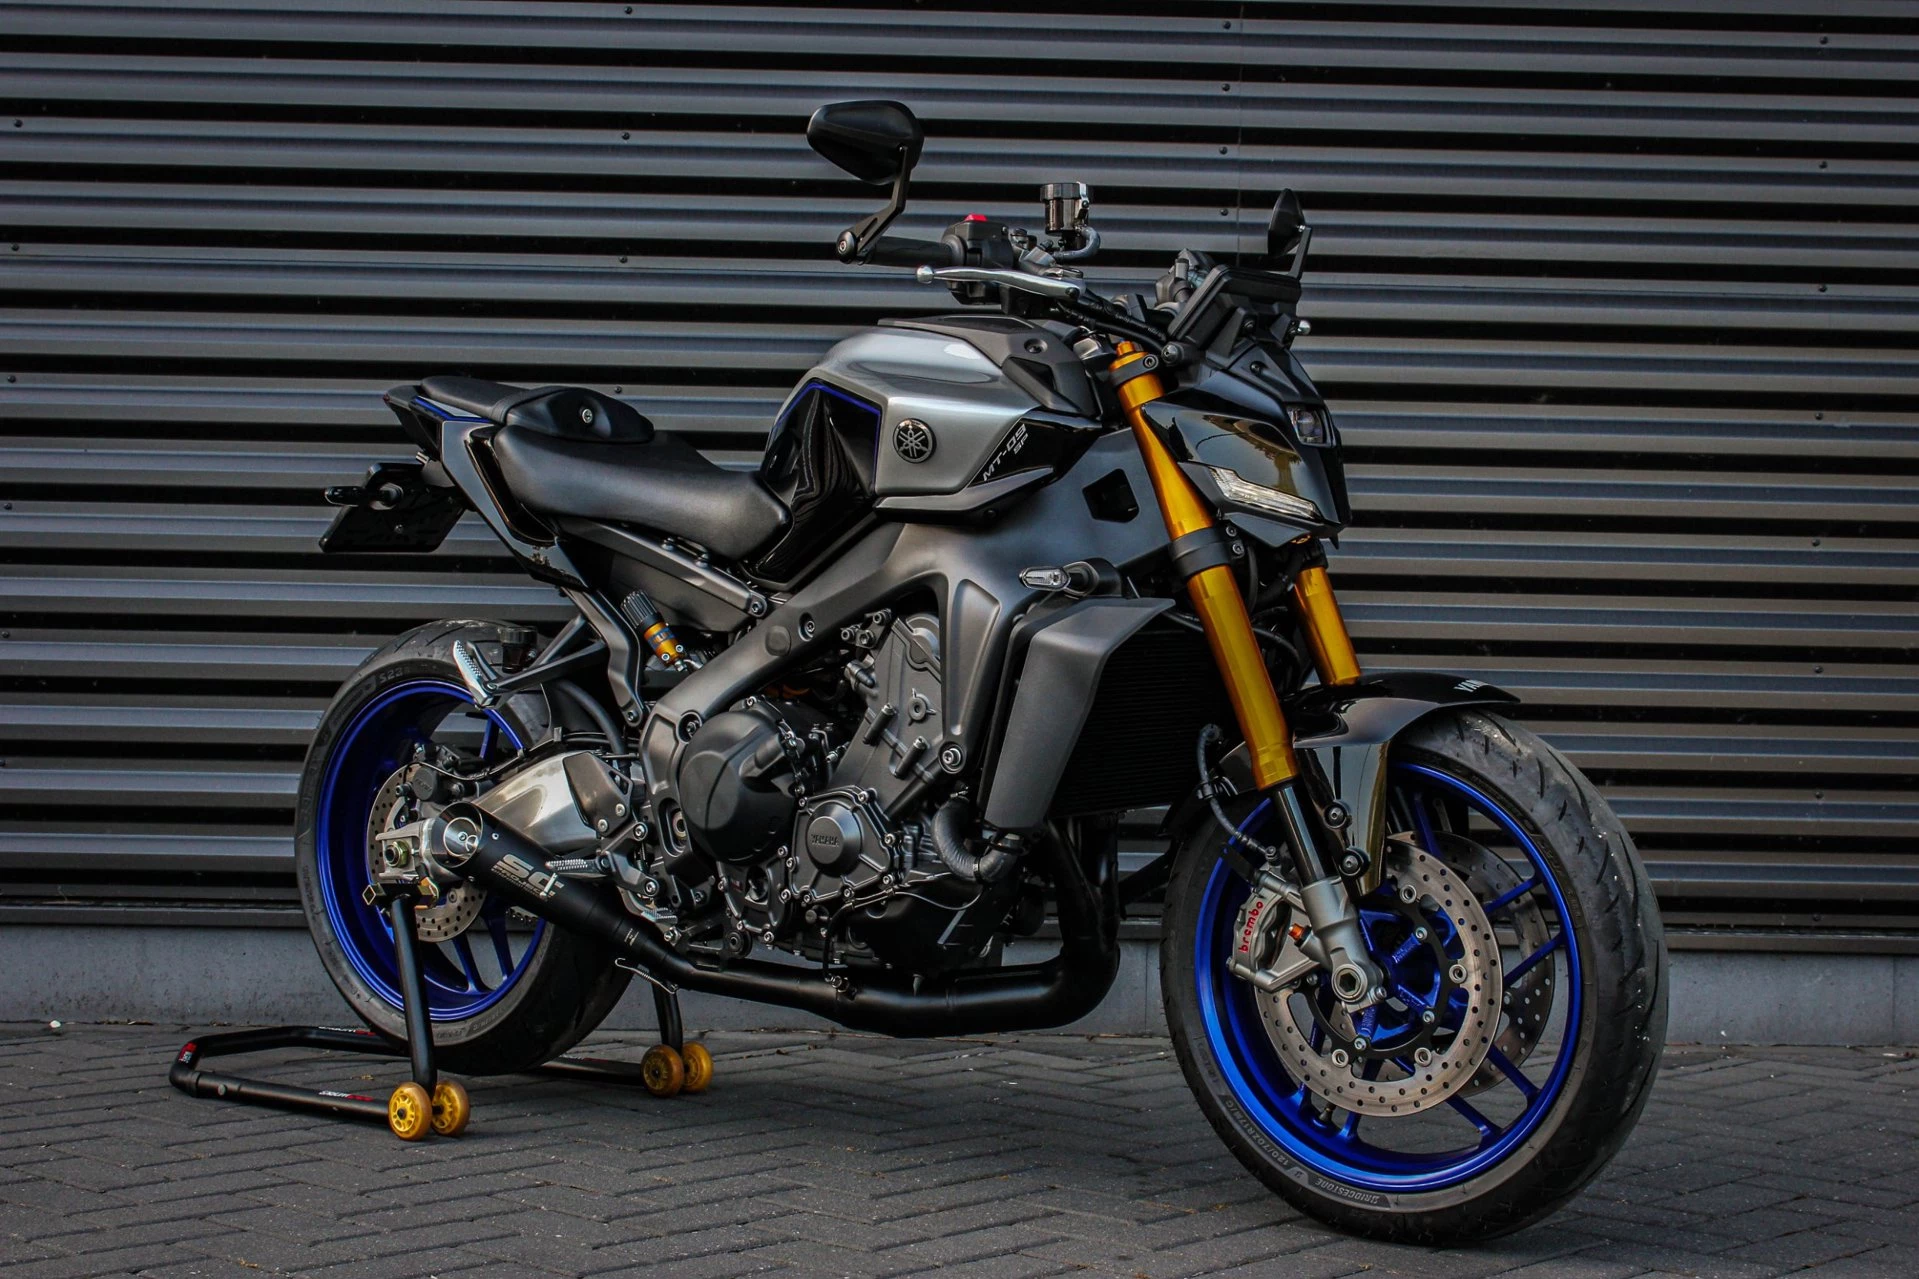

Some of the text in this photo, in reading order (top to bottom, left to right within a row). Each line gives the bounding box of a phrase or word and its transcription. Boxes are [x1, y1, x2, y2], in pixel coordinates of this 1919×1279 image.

[983, 423, 1027, 481] MT-09
[1013, 433, 1028, 454] SP
[1238, 901, 1264, 953] brembo
[1314, 1177, 1381, 1205] BRIDGESTONE
